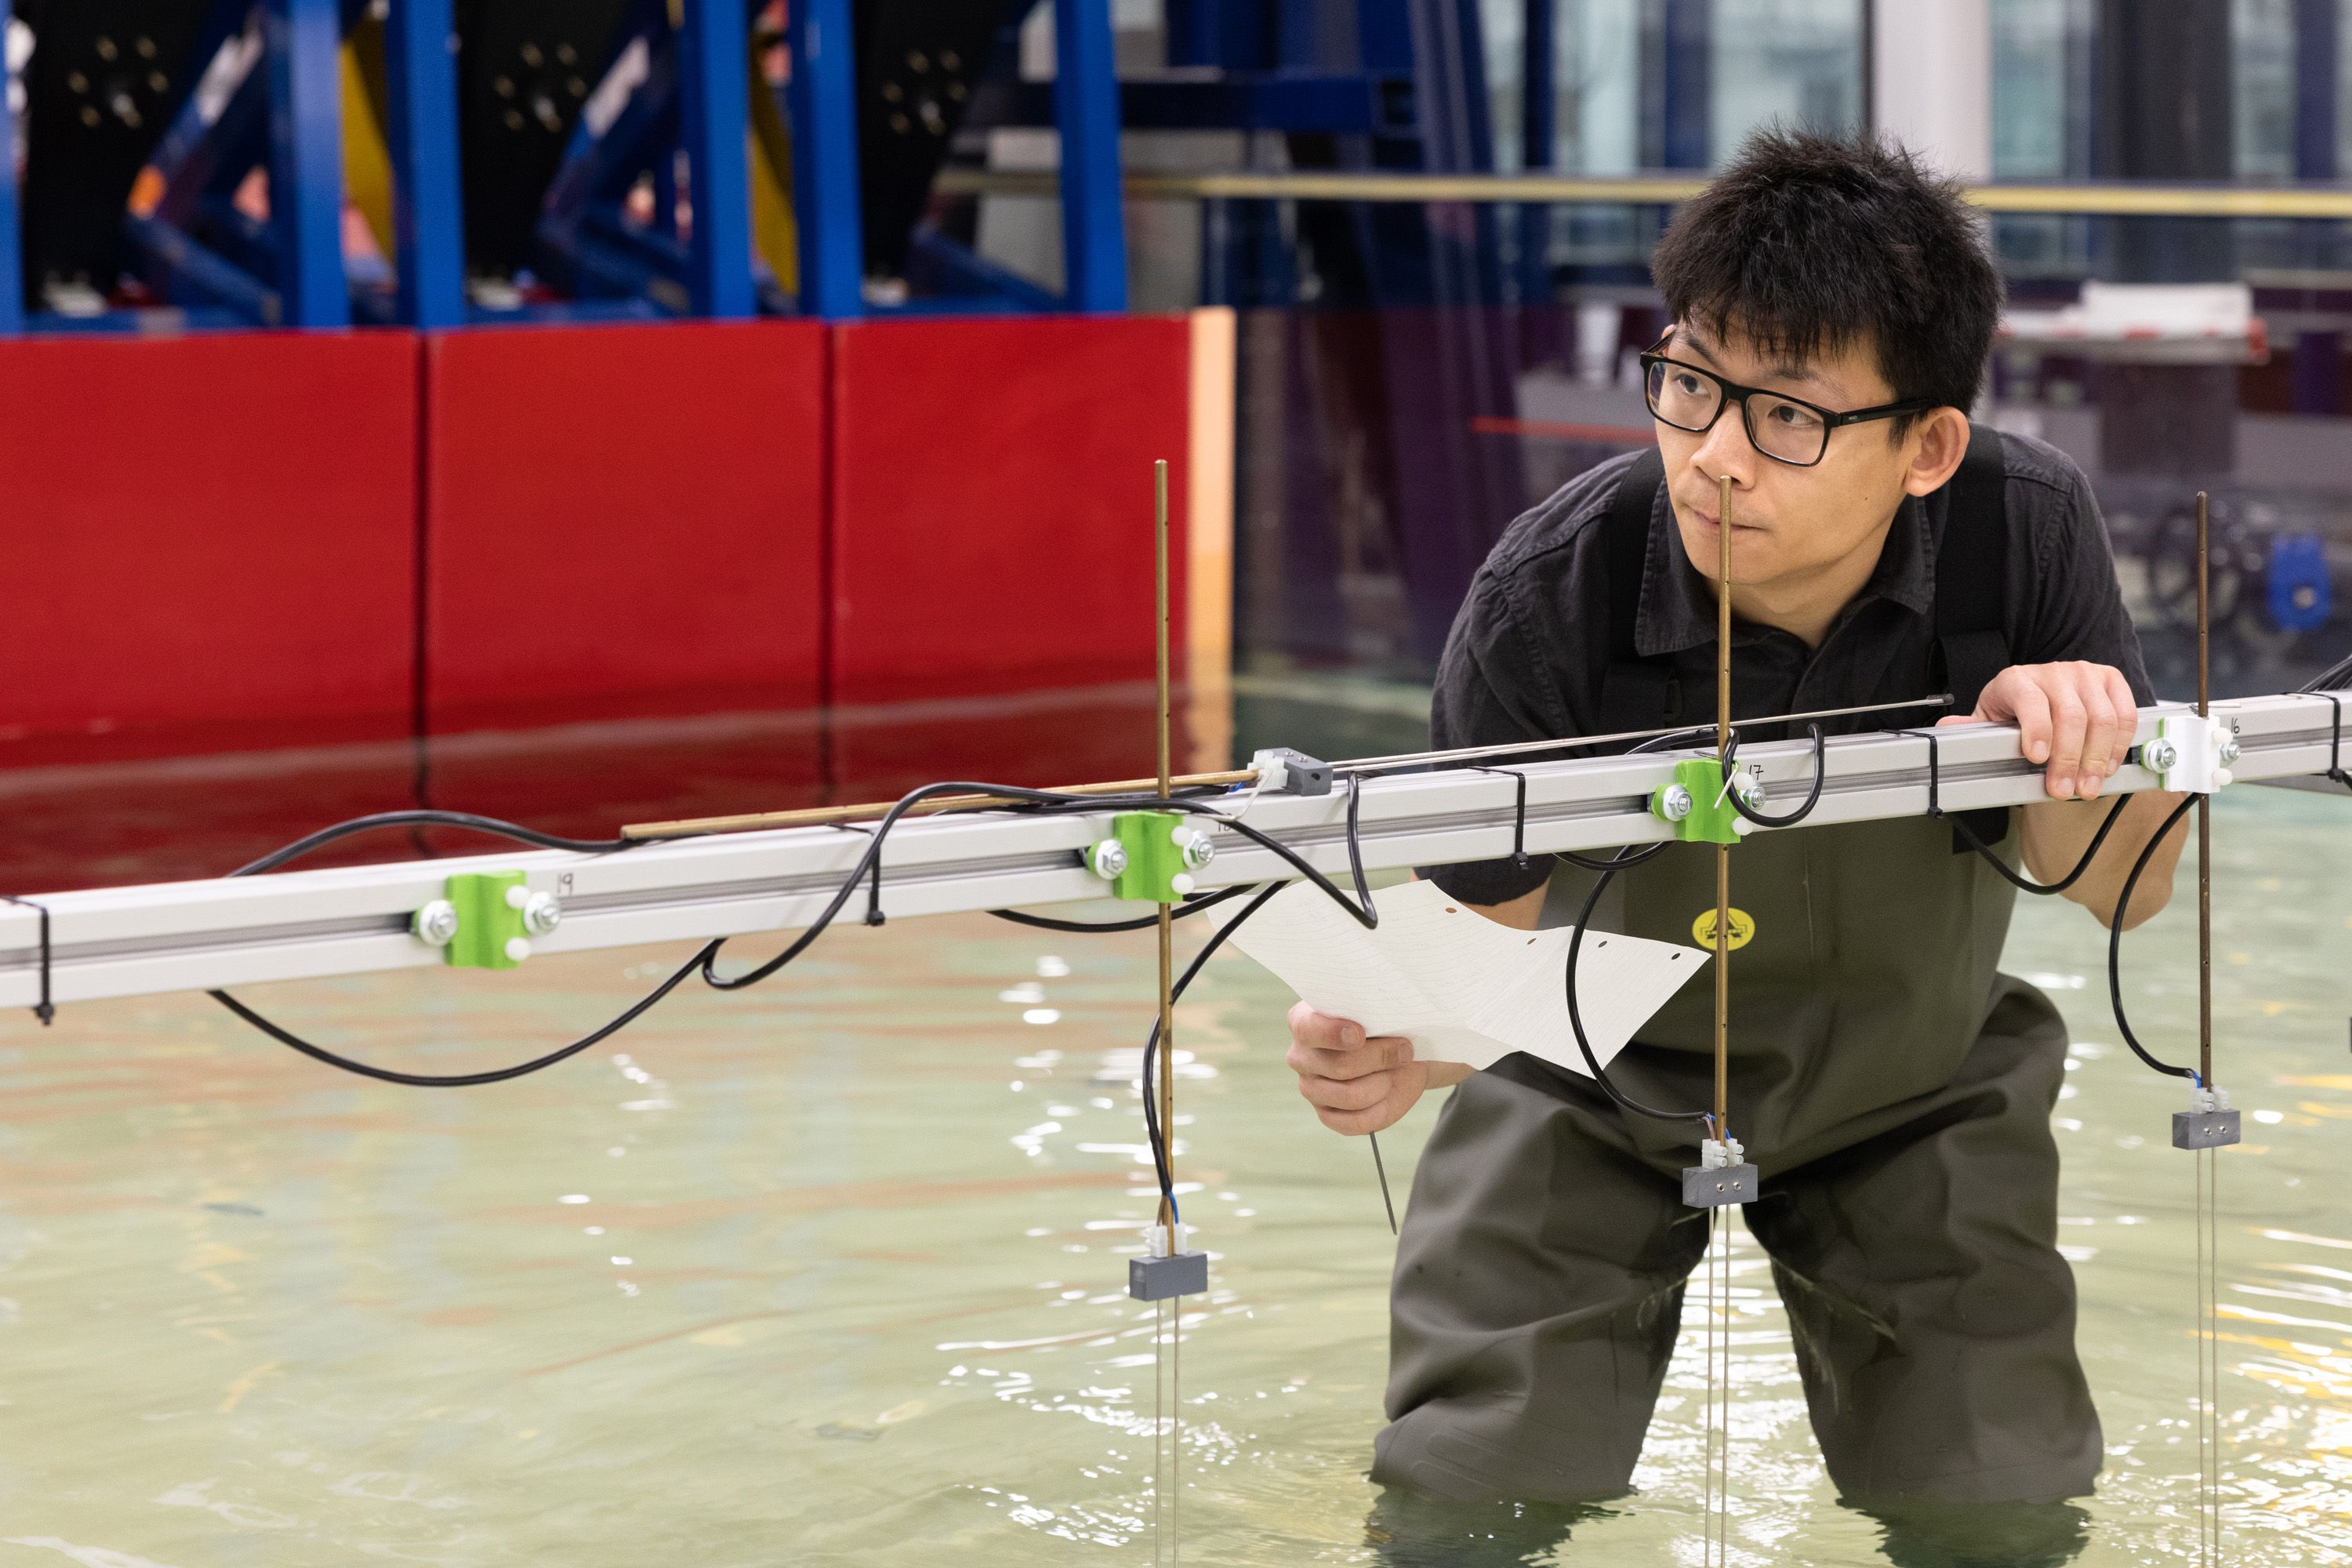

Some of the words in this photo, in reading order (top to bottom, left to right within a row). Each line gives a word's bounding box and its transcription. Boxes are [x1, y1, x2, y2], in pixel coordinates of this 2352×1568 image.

[2230, 715, 2241, 735] 16
[1749, 764, 1764, 780] 17
[556, 872, 573, 895] 19
